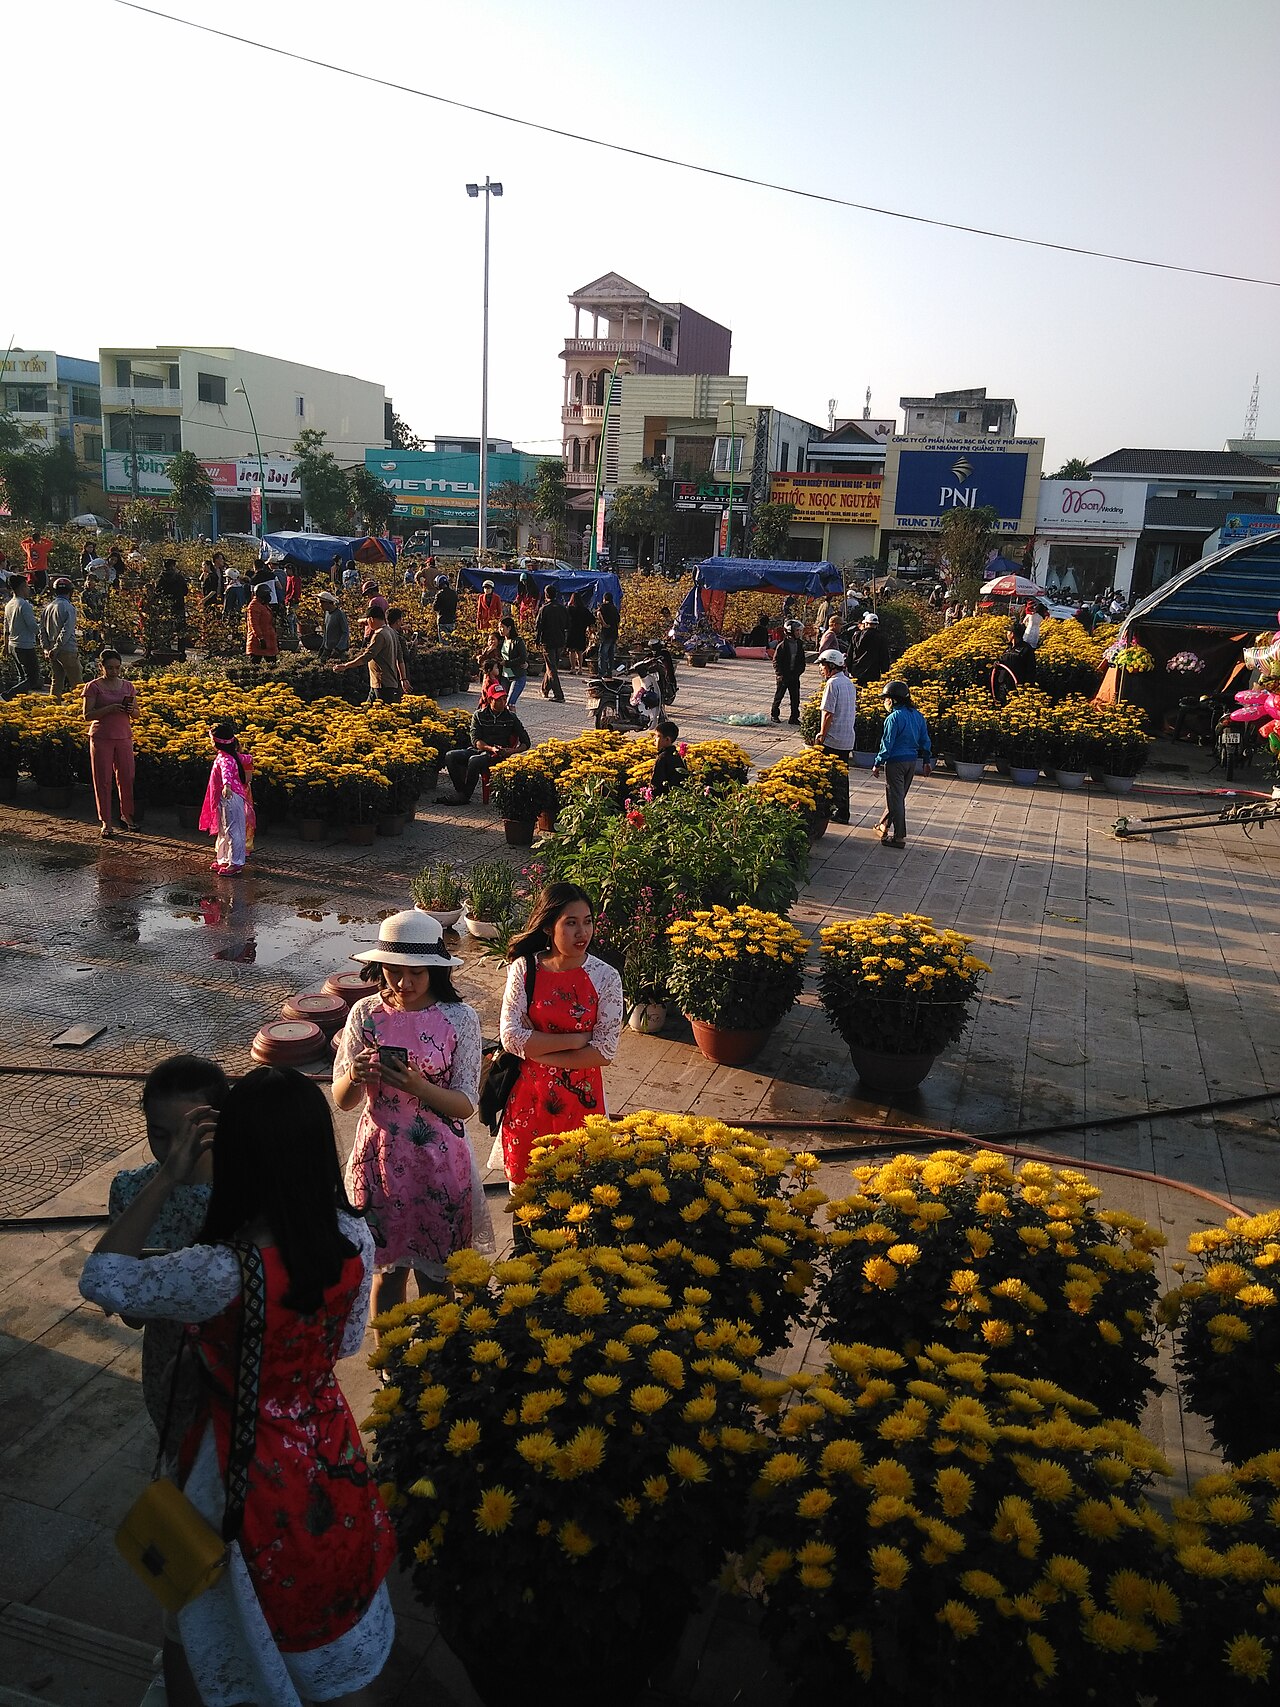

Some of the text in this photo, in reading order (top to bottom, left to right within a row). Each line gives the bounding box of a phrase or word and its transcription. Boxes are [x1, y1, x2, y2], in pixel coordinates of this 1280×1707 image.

[891, 435, 909, 443] CÔNG
[267, 468, 289, 487] Boy
[290, 470, 298, 484] 2
[679, 484, 744, 498] ERIC
[808, 492, 837, 511] NGỌC
[839, 491, 881, 509] NGUYÊN
[939, 486, 979, 509] PNJ
[1101, 506, 1124, 514] Wedding
[896, 517, 943, 528] TRUNG TÂ
[1002, 521, 1019, 531] PNJ
